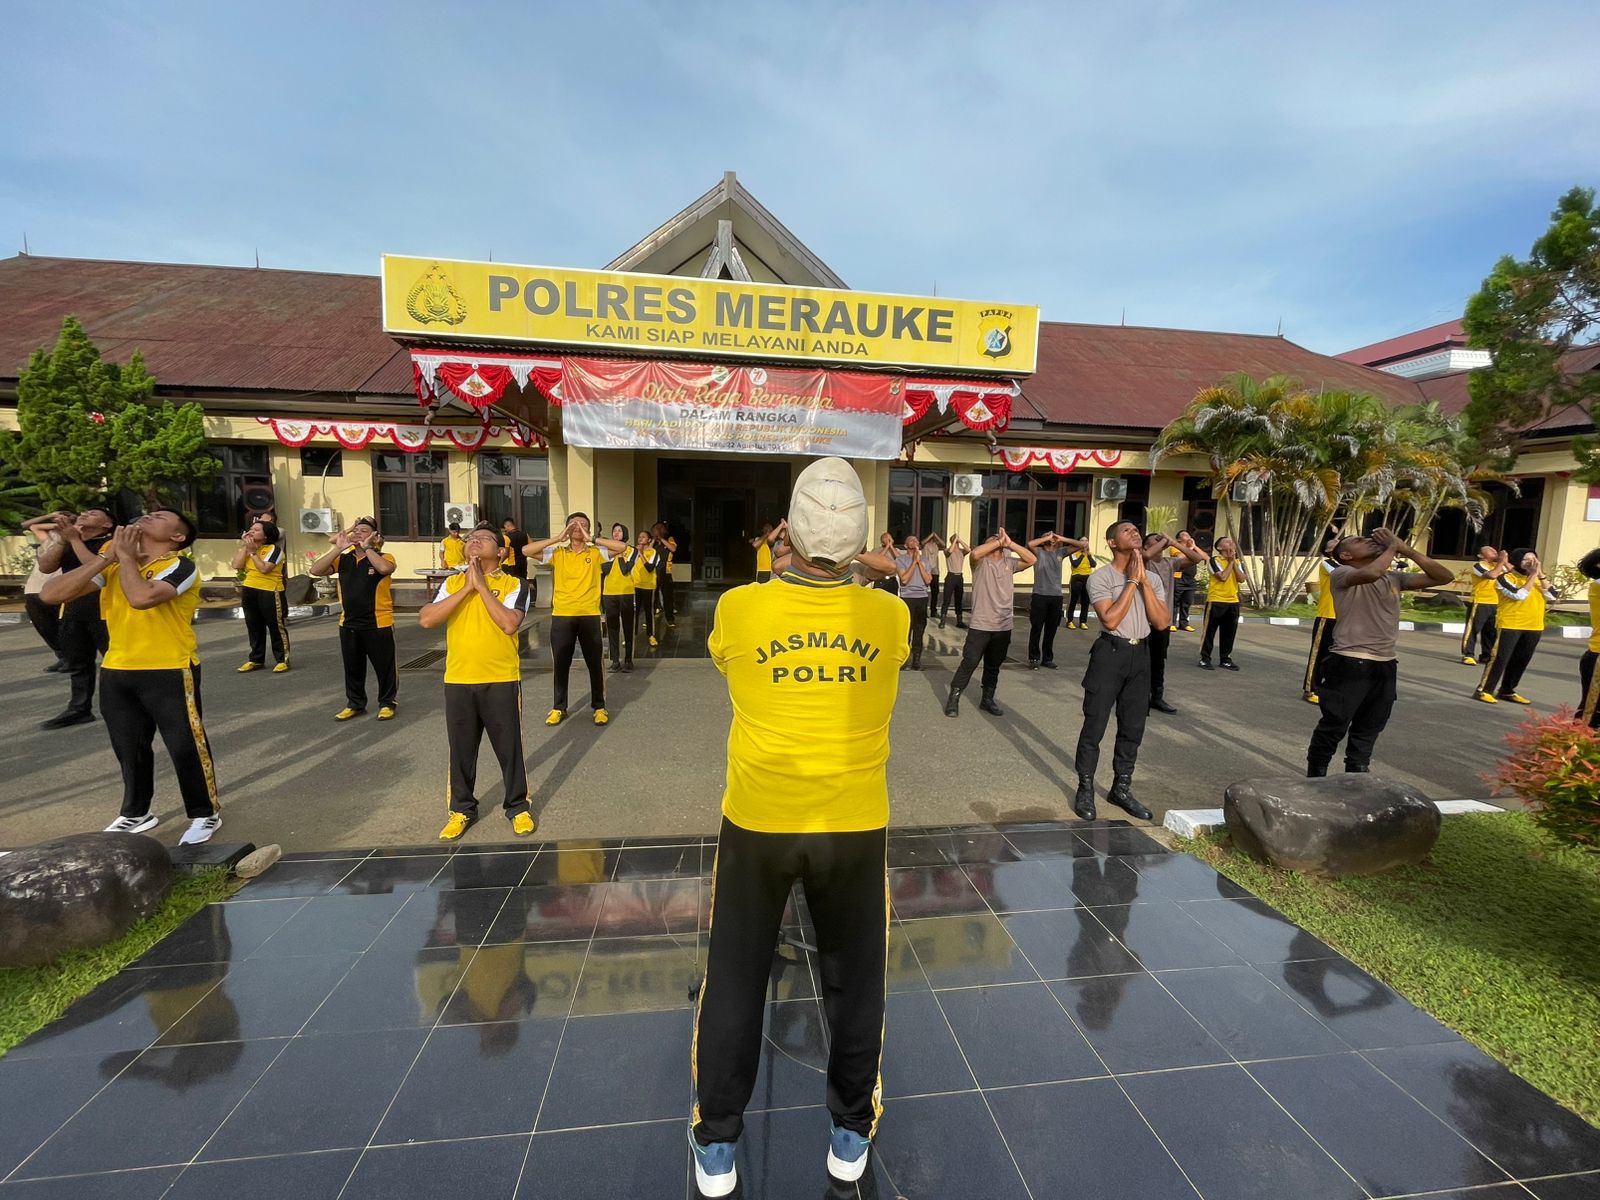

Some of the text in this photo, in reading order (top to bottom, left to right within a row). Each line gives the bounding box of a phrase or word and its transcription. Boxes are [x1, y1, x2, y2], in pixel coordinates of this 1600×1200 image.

[488, 275, 954, 343] POLRES MERAUKE
[980, 309, 1012, 319] PAPUA
[586, 323, 869, 356] KAMI SIAP MELAYANI ANDA
[641, 381, 688, 401] Olah
[694, 383, 743, 408] Raga
[624, 418, 652, 428] HARI
[655, 419, 682, 429] JADI
[734, 423, 785, 434] REPUBLIK
[785, 426, 848, 436] INDONESIA
[680, 408, 798, 424] DALAM RANGKA
[756, 632, 880, 664] JASMANI
[772, 665, 867, 684] POLRI
